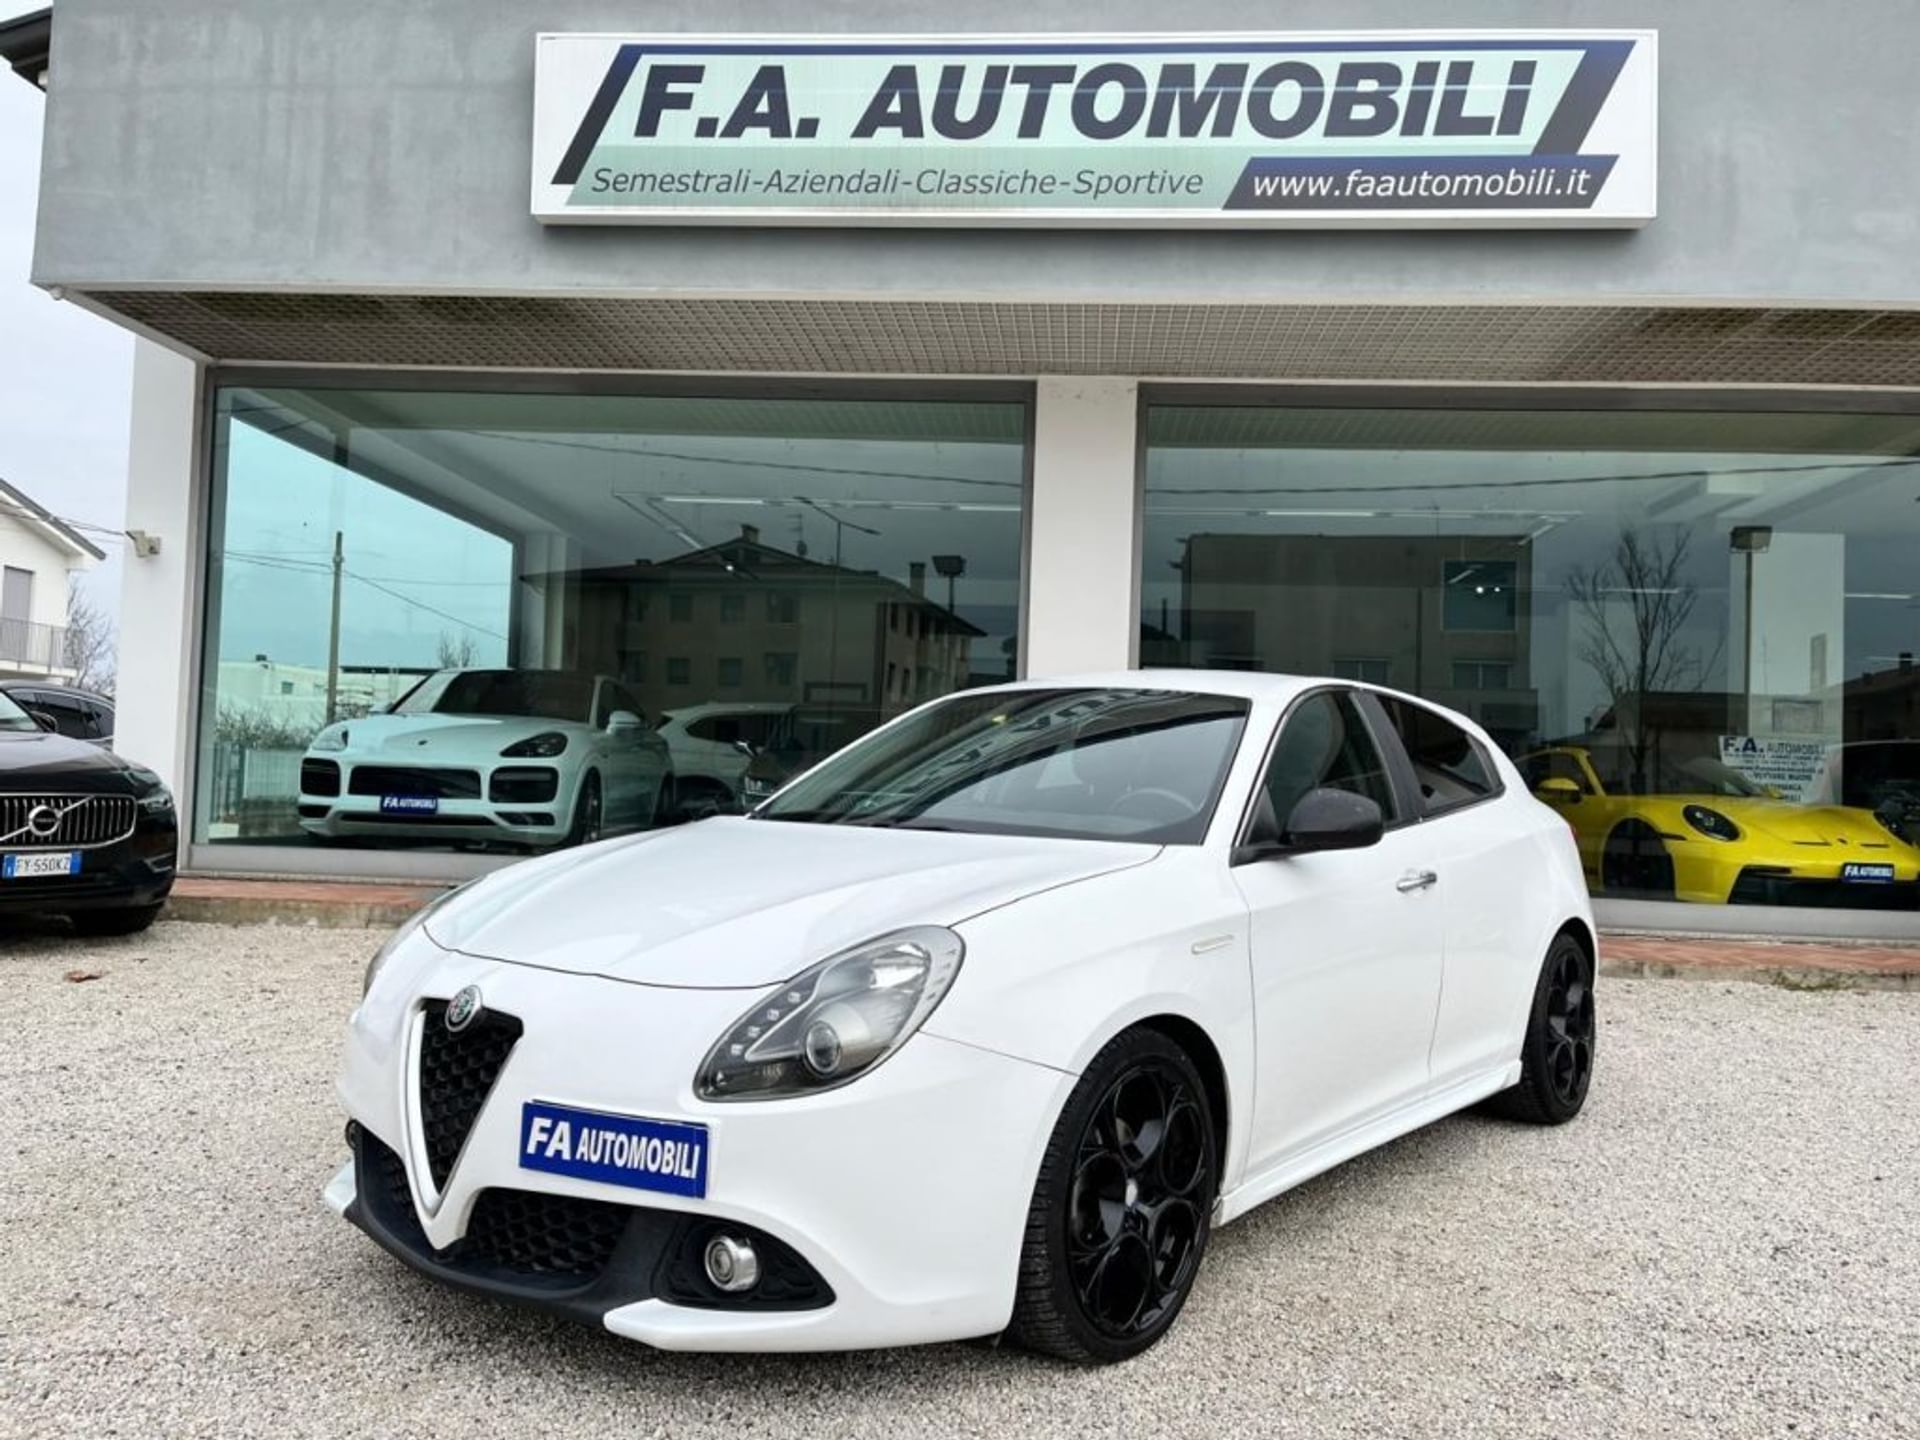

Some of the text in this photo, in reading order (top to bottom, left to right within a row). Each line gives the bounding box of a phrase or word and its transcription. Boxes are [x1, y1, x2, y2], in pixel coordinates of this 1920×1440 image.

[633, 60, 1538, 140] F.A. AUTOMOBILI
[591, 166, 1204, 200] Semestrali-Aziendali-Classiche-Sportive
[1252, 168, 1592, 197] www.faautomobili.it
[1723, 737, 1764, 753] F.A.
[526, 1116, 701, 1179] FA AUTOMOBILI
